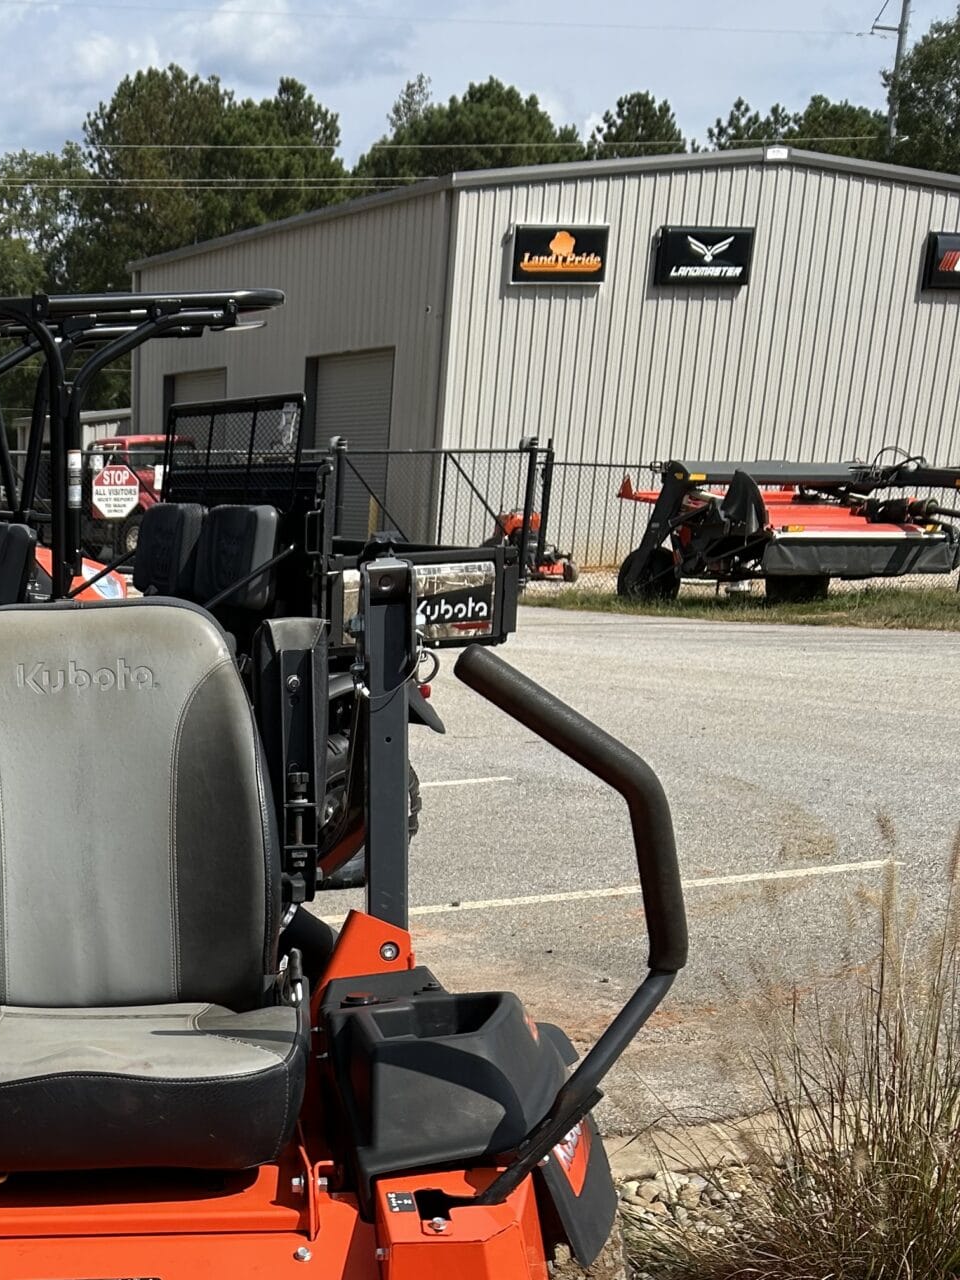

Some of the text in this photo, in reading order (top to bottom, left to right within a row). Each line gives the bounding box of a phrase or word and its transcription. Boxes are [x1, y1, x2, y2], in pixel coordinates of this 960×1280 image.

[523, 252, 601, 265] Land Pride
[670, 265, 743, 277] LANDMASTER
[102, 470, 129, 485] STOP
[95, 488, 136, 496] ALL VISITORS
[15, 657, 156, 695] Kubota
